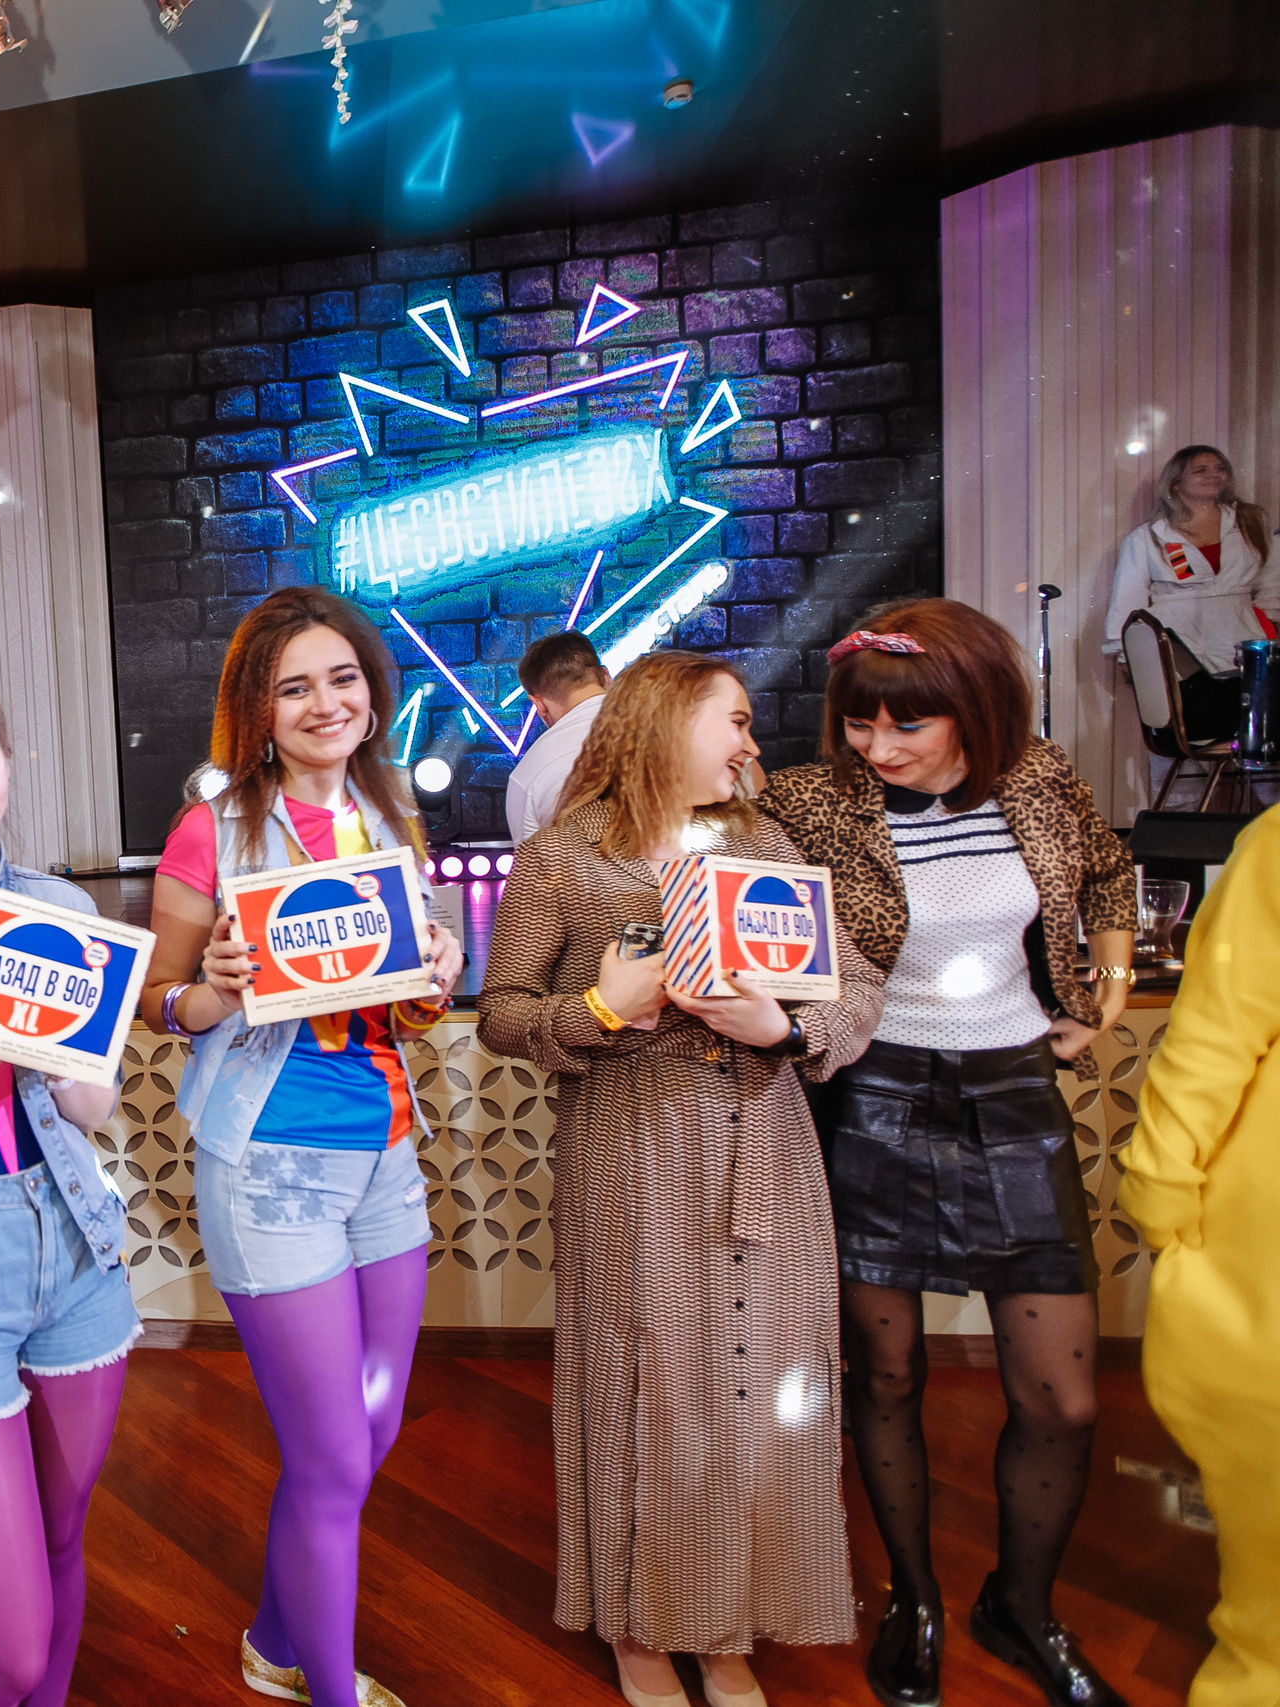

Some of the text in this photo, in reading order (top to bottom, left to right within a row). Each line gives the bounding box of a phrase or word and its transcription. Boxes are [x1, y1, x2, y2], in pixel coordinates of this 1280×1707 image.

[270, 910, 388, 953] НАЗАД В 90е
[736, 908, 814, 939] НАЗАД В 90е
[317, 951, 352, 981] XL
[767, 943, 790, 969] XL
[43, 969, 60, 997] В
[62, 974, 99, 1009] 90е
[7, 999, 42, 1034] XL
